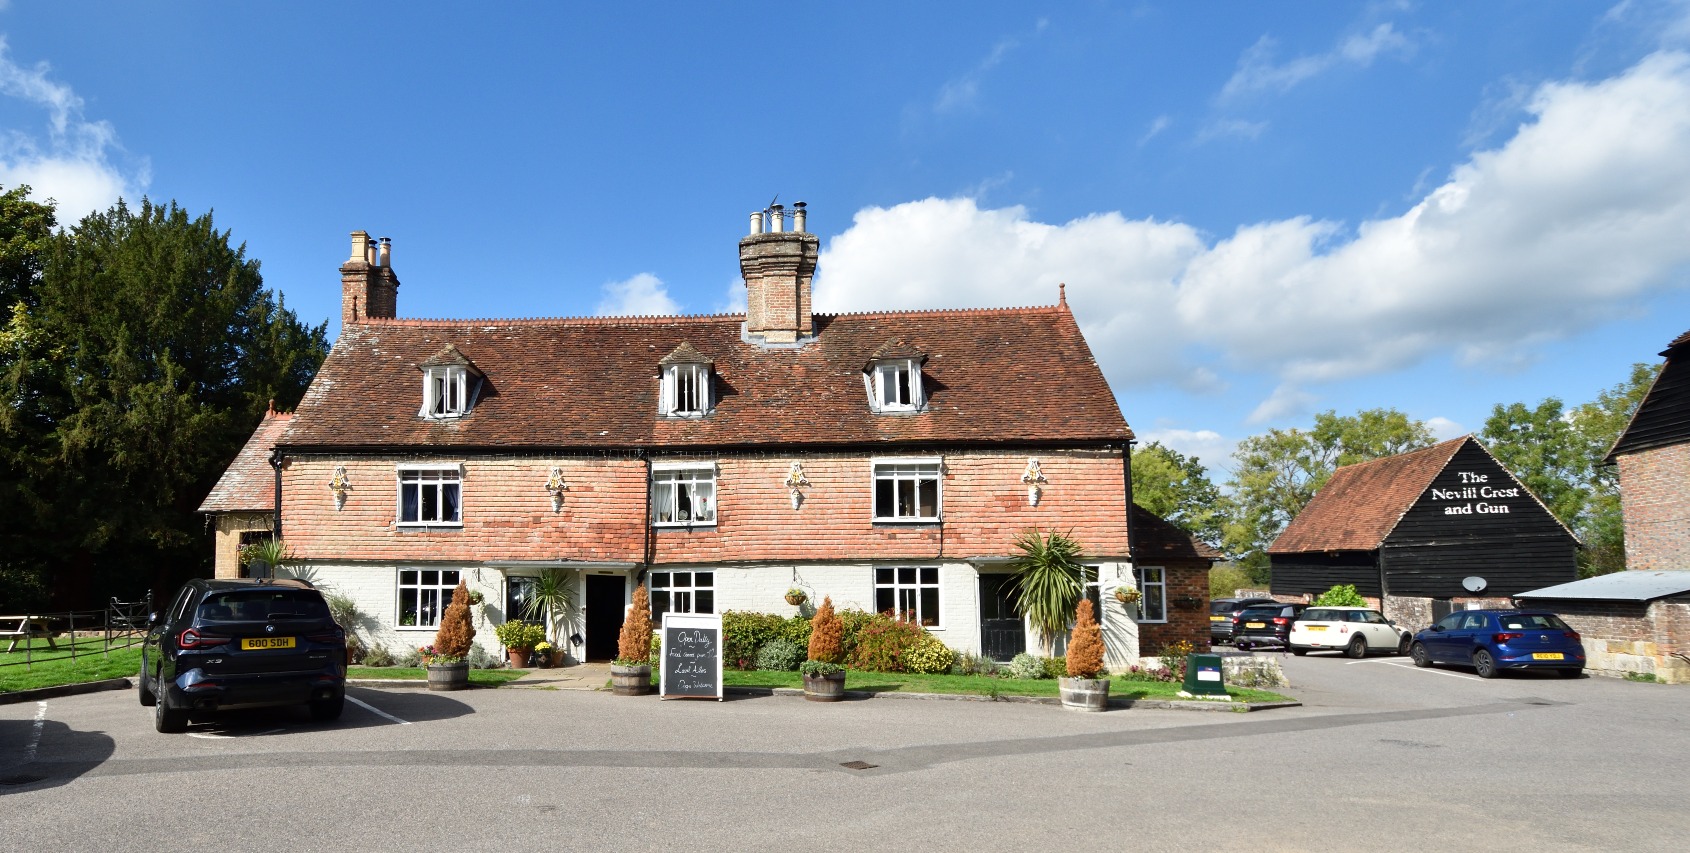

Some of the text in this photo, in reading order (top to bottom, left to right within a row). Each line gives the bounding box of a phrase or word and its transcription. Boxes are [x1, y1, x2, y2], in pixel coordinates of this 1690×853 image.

[1458, 471, 1488, 483] The
[1431, 486, 1520, 500] Nevill Crest
[1444, 502, 1510, 515] and Gun
[248, 639, 289, 648] 600 SDH
[678, 631, 693, 645] Open
